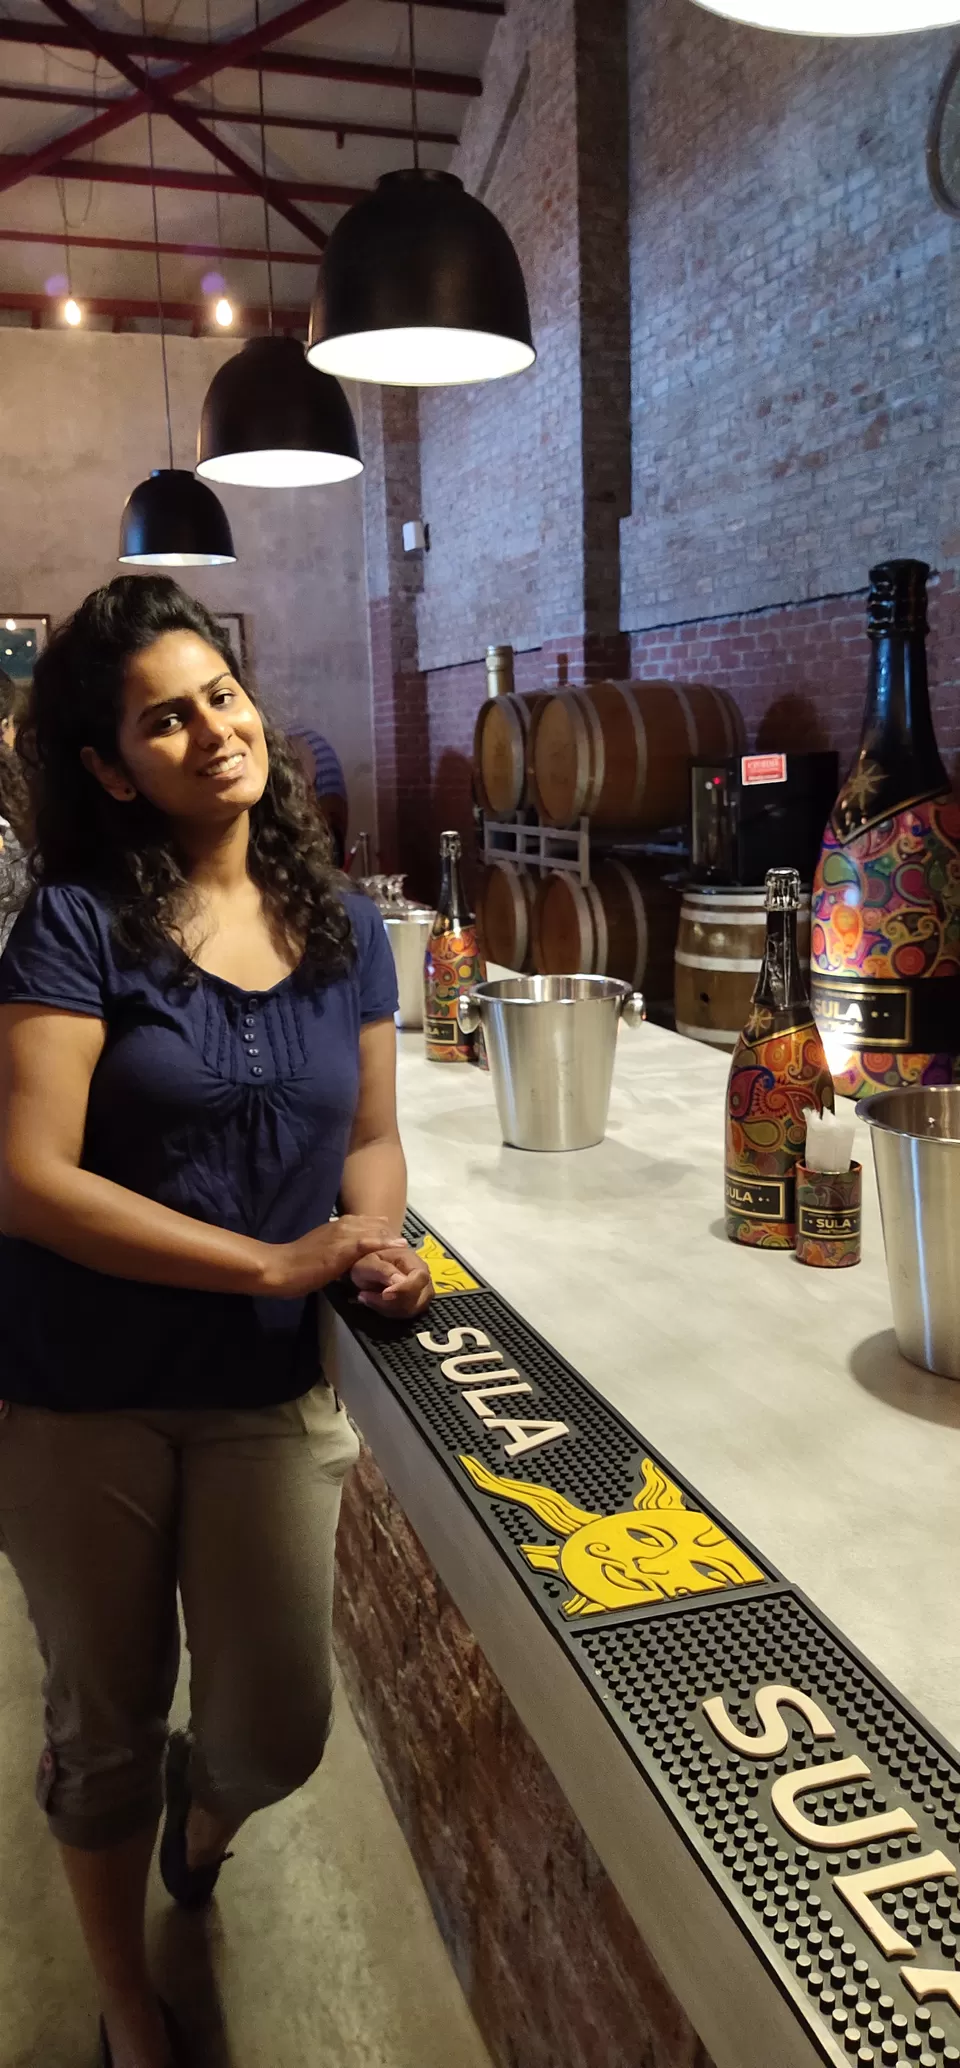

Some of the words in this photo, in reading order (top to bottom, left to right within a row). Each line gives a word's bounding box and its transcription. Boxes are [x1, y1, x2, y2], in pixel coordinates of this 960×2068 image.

[812, 999, 863, 1022] SULA
[816, 1218, 852, 1228] SULA
[416, 1327, 570, 1458] SULA
